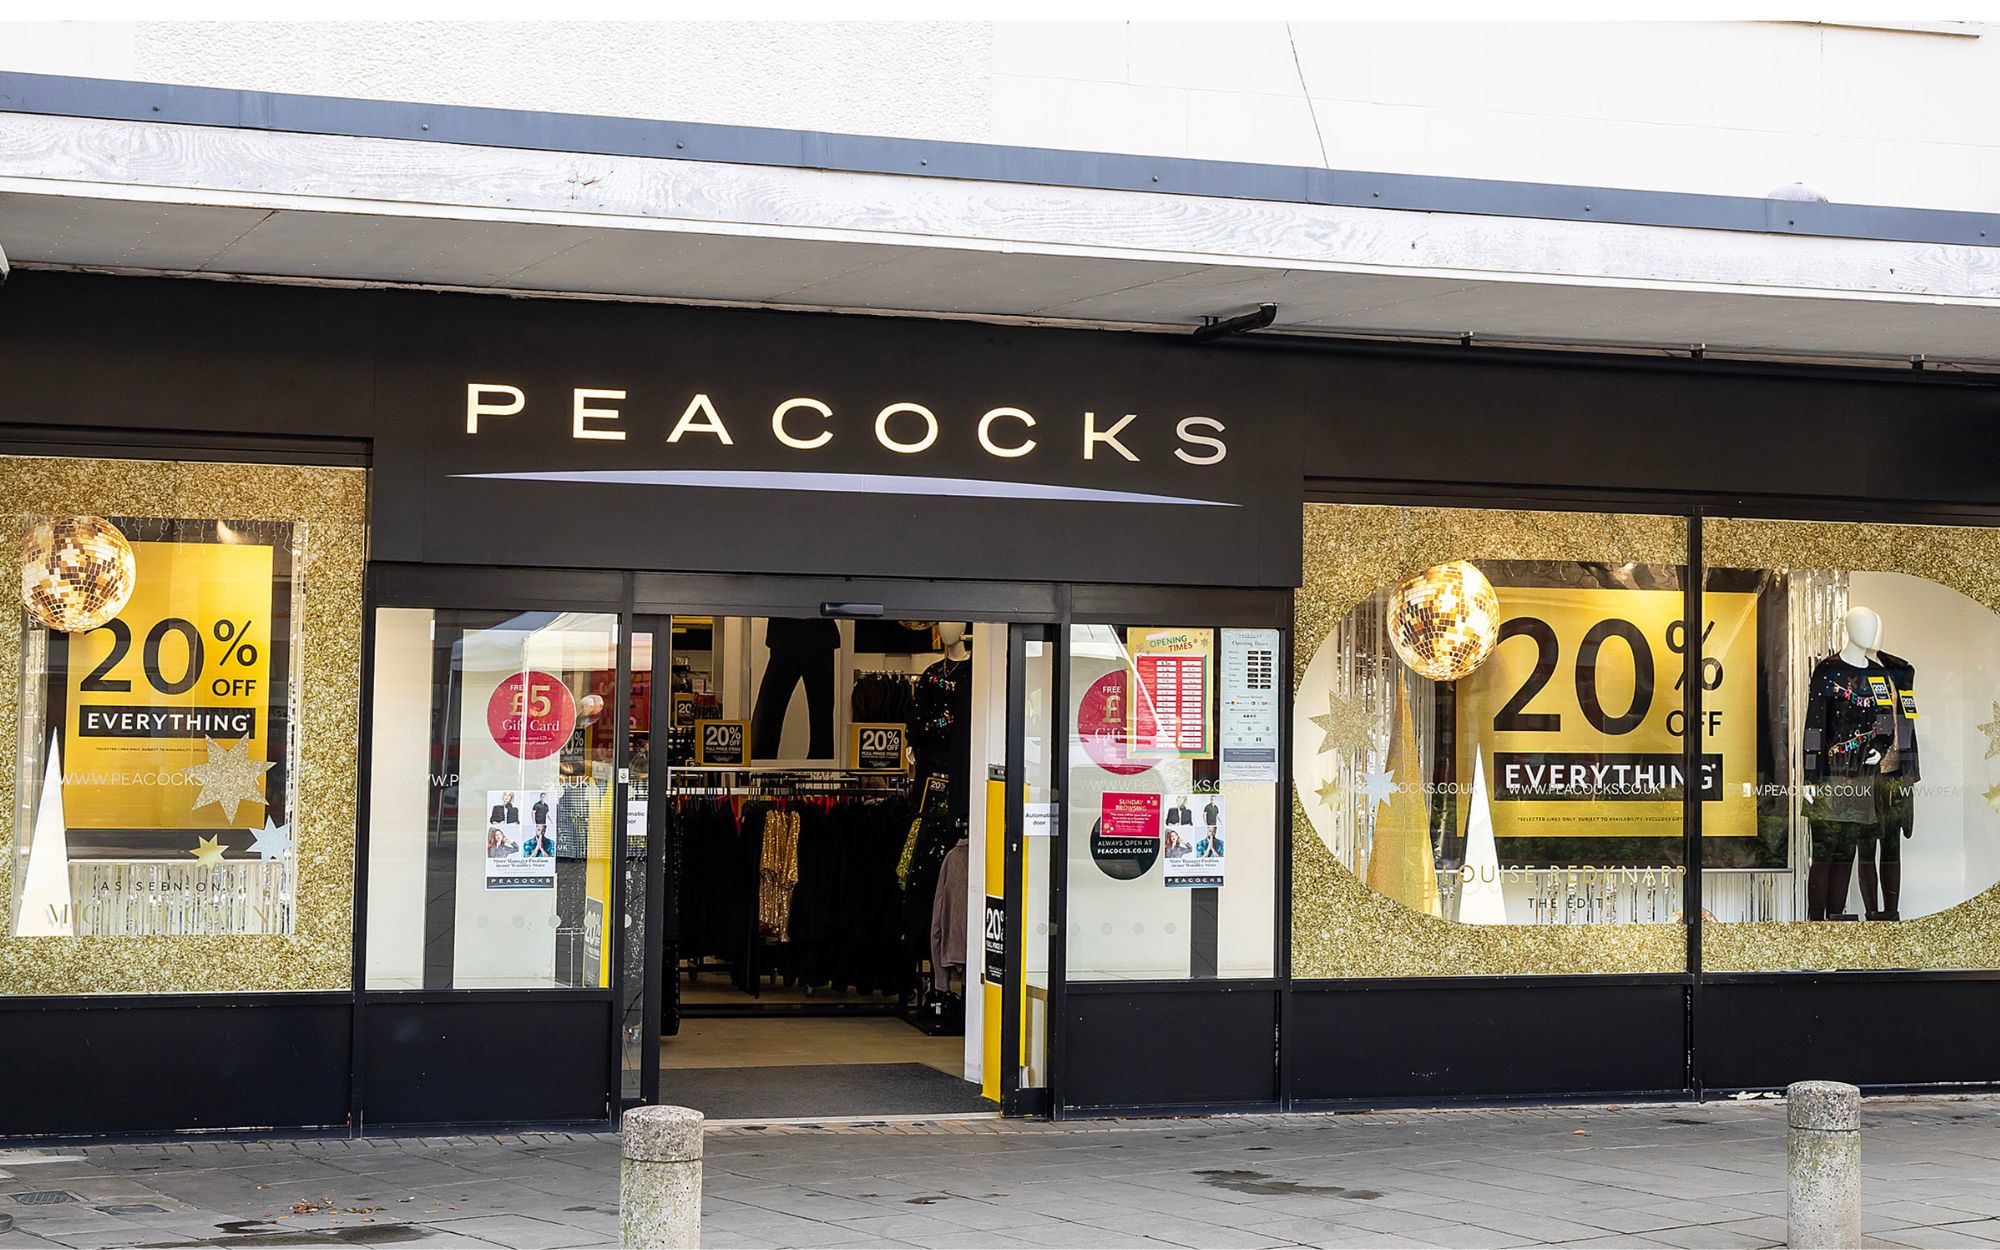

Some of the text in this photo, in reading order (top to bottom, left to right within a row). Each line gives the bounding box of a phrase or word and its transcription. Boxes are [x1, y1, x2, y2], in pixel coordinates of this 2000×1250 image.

[466, 382, 1227, 466] PEACOCKS
[1149, 635, 1187, 648] OPENING
[1168, 641, 1193, 652] TIMES
[80, 617, 258, 695] 20%
[1493, 616, 1724, 736] 20%
[212, 679, 257, 697] OFF
[509, 684, 551, 718] £5
[502, 719, 560, 732] Gif Card
[1666, 710, 1723, 736] OF
[705, 726, 741, 746] 20%
[861, 730, 899, 751] 20%
[1508, 782, 1662, 795] WWW.PEACOCKS.CO.UK
[1442, 864, 1688, 884] LOUISE REDKNAPP
[100, 881, 221, 892] AS SEEN ON
[1527, 897, 1604, 909] THE EDIT
